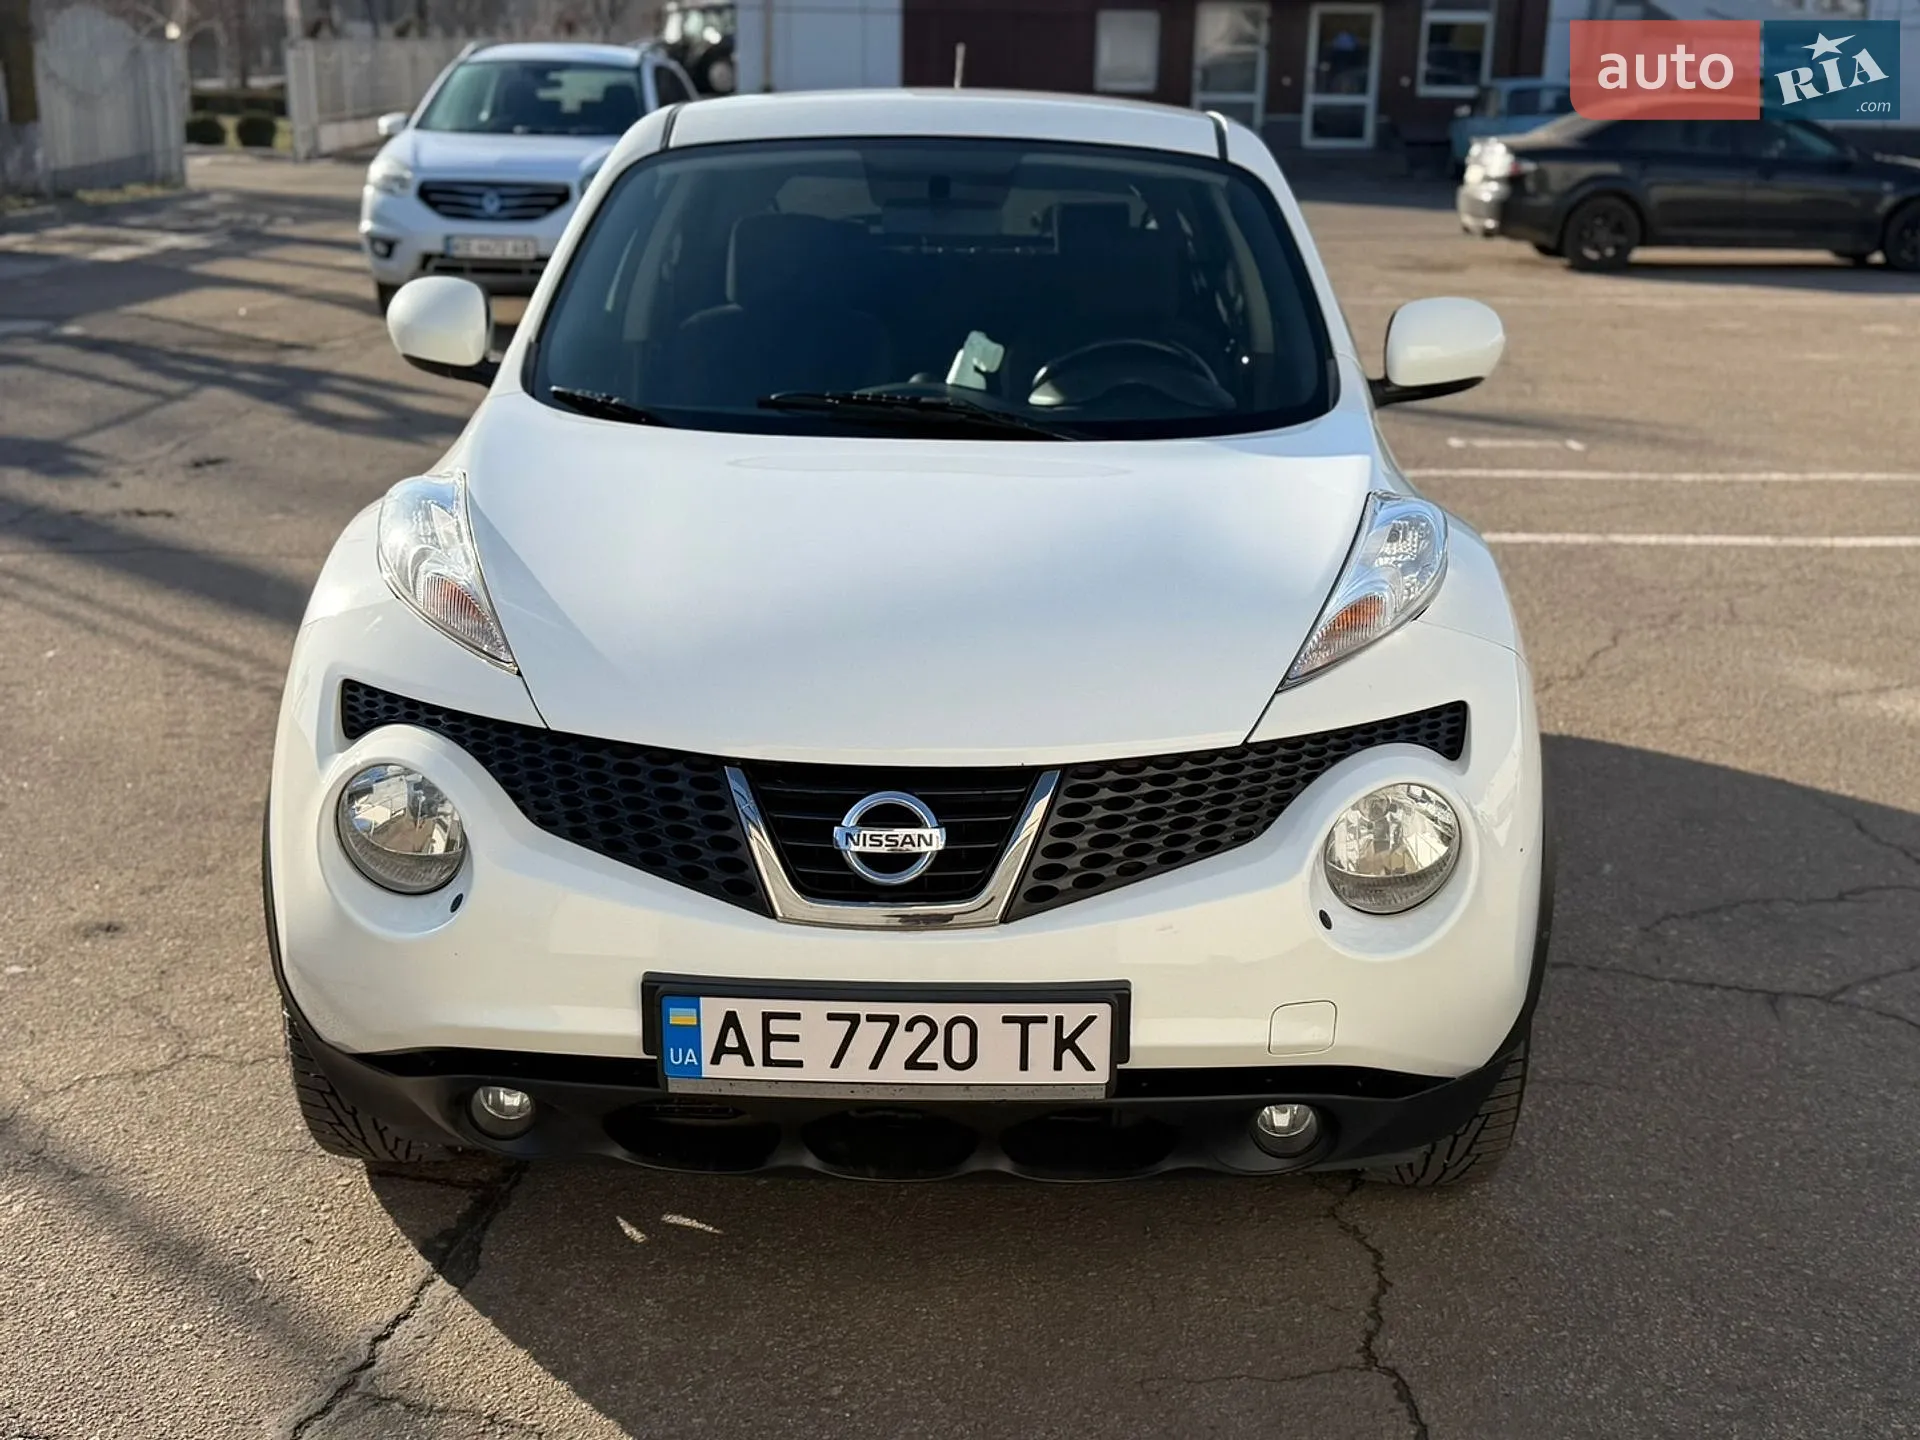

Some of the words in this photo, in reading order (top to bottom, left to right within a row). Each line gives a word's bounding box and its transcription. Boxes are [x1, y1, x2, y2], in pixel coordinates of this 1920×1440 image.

[845, 832, 933, 847] NISSAN
[710, 1010, 804, 1069] AE
[826, 1012, 979, 1072] 7720
[1001, 1014, 1098, 1072] TK
[669, 1047, 698, 1066] UA
